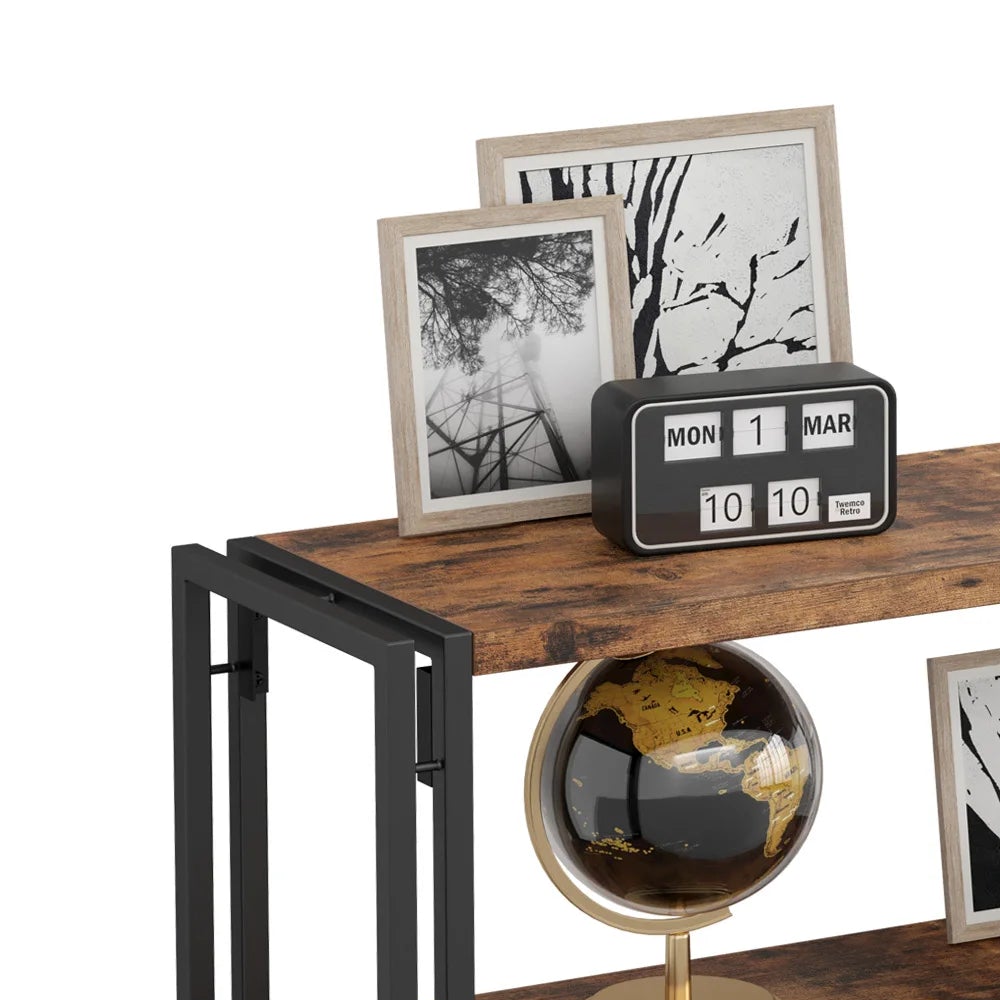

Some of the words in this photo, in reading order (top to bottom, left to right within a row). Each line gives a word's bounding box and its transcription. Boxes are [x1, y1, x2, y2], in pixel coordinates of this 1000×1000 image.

[667, 424, 716, 448] MON
[749, 414, 762, 446] 1
[804, 413, 852, 437] MAR
[705, 492, 743, 524] 10
[772, 486, 810, 518] 10
[835, 499, 866, 509] Twemco
[839, 506, 861, 517] Retro
[641, 701, 661, 711] CANADA
